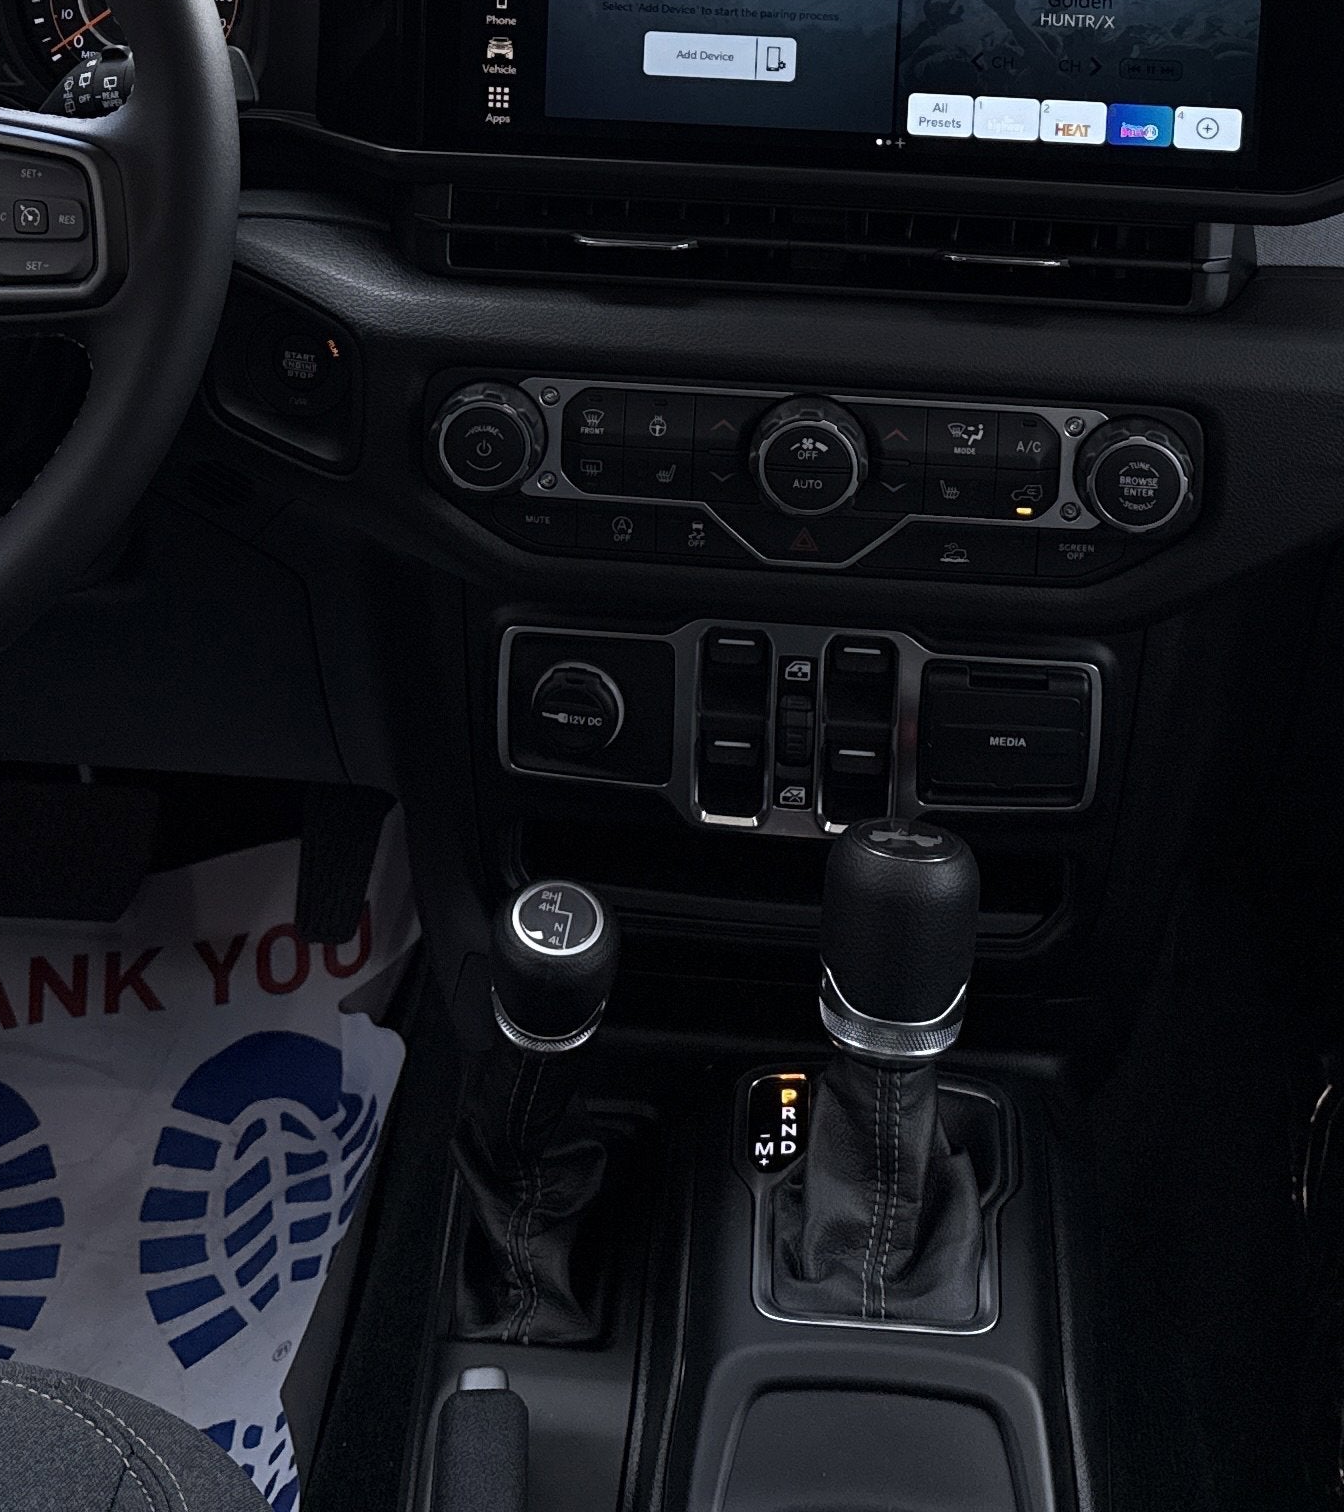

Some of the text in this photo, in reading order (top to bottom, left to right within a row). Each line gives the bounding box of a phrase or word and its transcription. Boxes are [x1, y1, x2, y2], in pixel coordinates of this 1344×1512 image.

[60, 8, 74, 20] 10
[485, 15, 517, 26] Phone
[1039, 12, 1116, 30] HUNTR/X
[676, 49, 735, 63] Add Device
[482, 63, 517, 75] Vehicle
[991, 56, 1016, 70] CH
[1058, 59, 1082, 74] CH
[932, 101, 948, 114] All
[485, 113, 511, 125] Apps
[918, 116, 962, 130] Presets
[1054, 122, 1091, 138] HEAT
[58, 214, 76, 225] RES
[284, 350, 317, 362] START
[579, 426, 605, 436] FRONT
[953, 447, 976, 455] MODE
[1016, 440, 1042, 454] A/C
[796, 450, 818, 460] OFF
[1128, 461, 1151, 472] TUNE
[791, 478, 823, 490] AUTO
[1119, 476, 1159, 487] BROWSE
[1123, 487, 1155, 498] ENTER
[1122, 499, 1155, 512] SCROLL
[525, 515, 551, 525] MUTE
[613, 534, 631, 543] OFF
[688, 539, 705, 548] OFF
[1058, 543, 1096, 554] SCREEN
[1066, 551, 1086, 561] OFF
[568, 714, 603, 727] 12V DC
[989, 736, 1028, 748] MEDIA
[541, 890, 558, 901] 2H
[538, 902, 556, 913] 4H
[553, 922, 564, 933] N
[548, 935, 562, 946] 4L
[193, 899, 372, 1007] YOU
[781, 1089, 798, 1104] P
[781, 1106, 797, 1121] R
[781, 1123, 798, 1138] N
[754, 1141, 775, 1157] M
[781, 1140, 797, 1155] D
